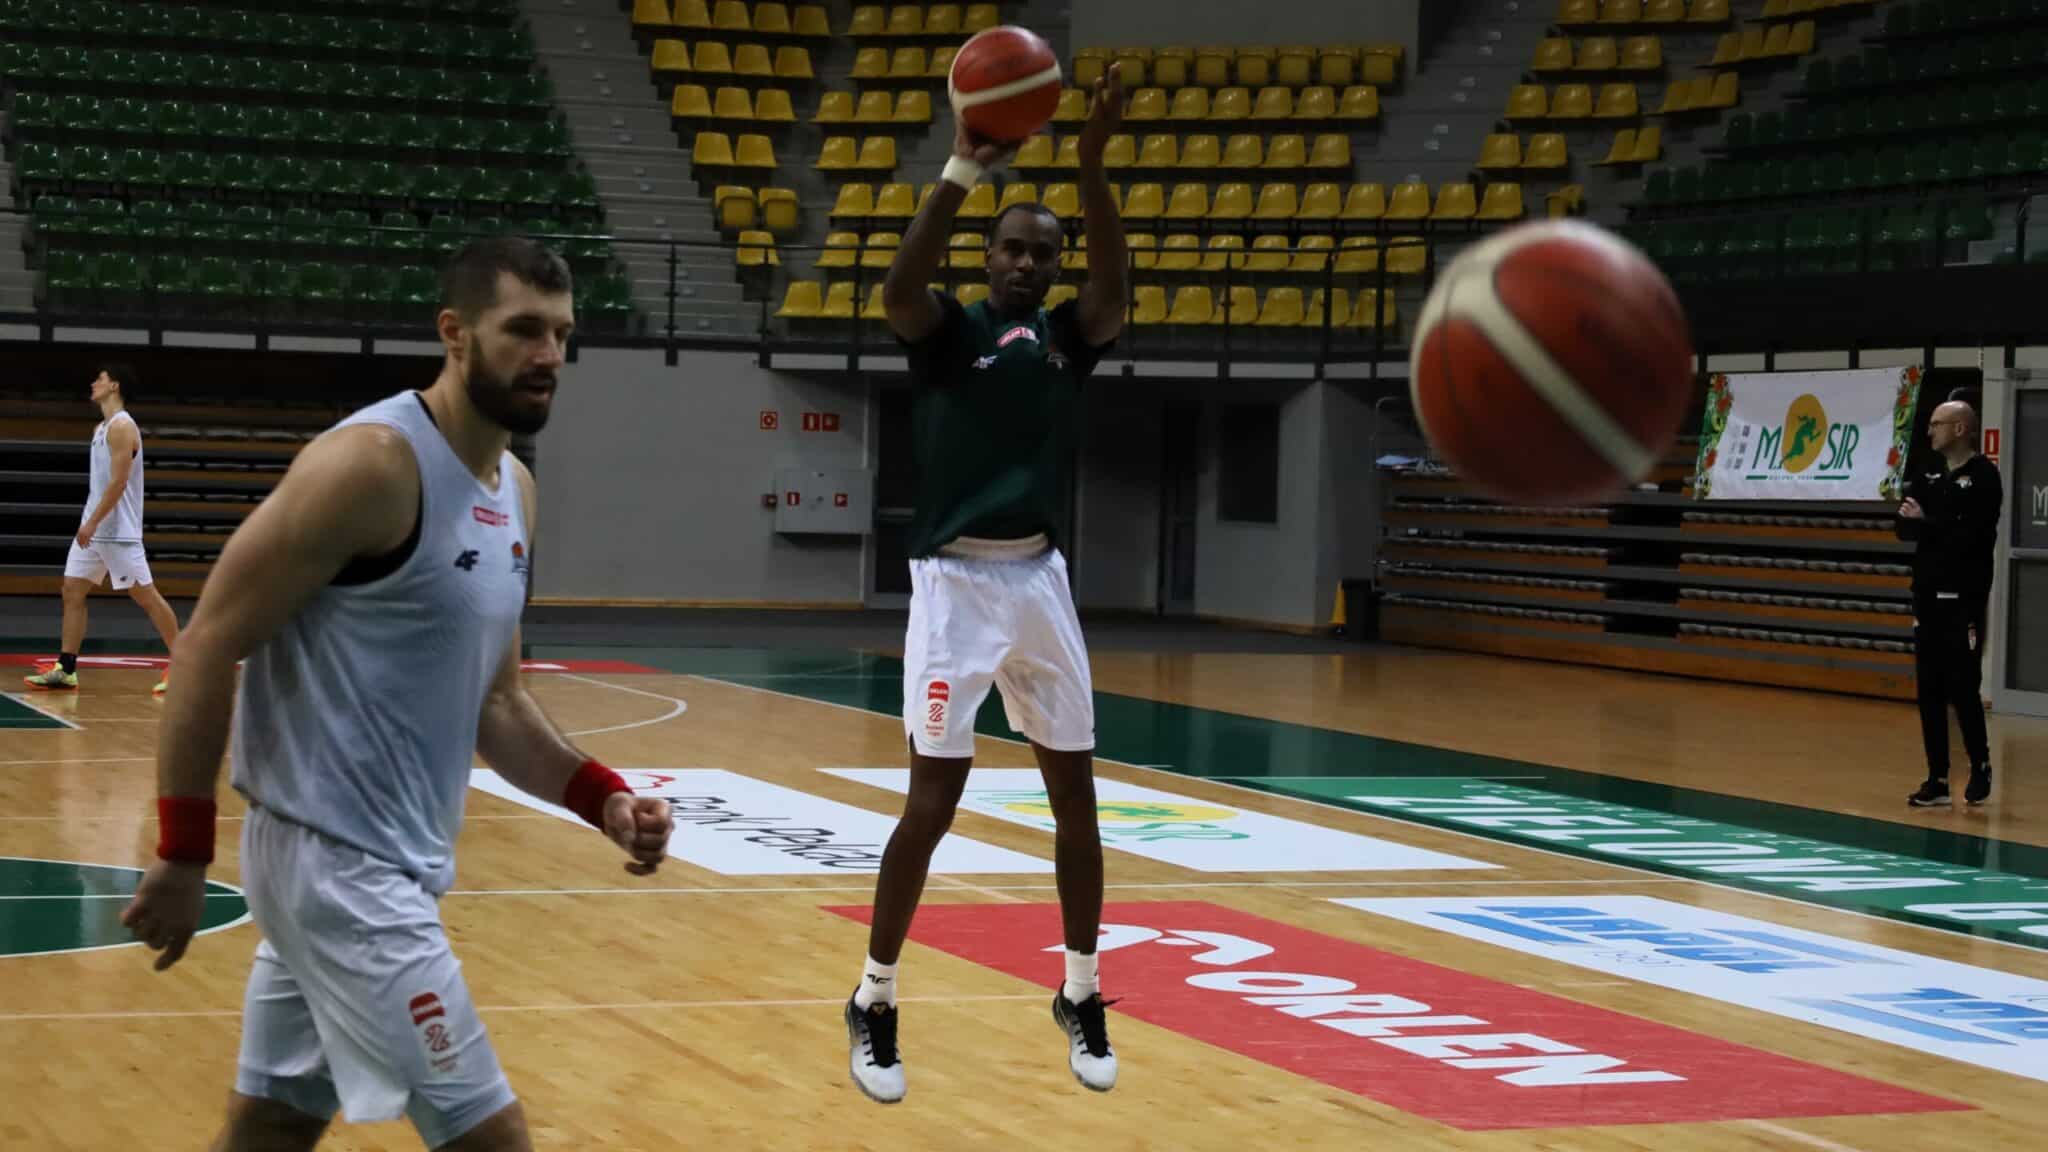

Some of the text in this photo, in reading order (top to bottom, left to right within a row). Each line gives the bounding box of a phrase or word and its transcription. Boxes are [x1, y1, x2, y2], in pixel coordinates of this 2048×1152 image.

[453, 549, 480, 572] 4F
[714, 827, 880, 869] Pekao
[1345, 795, 2048, 937] ZIELONA G
[1473, 905, 1845, 974] ARPOL
[1184, 970, 1688, 1087] ORLEN
